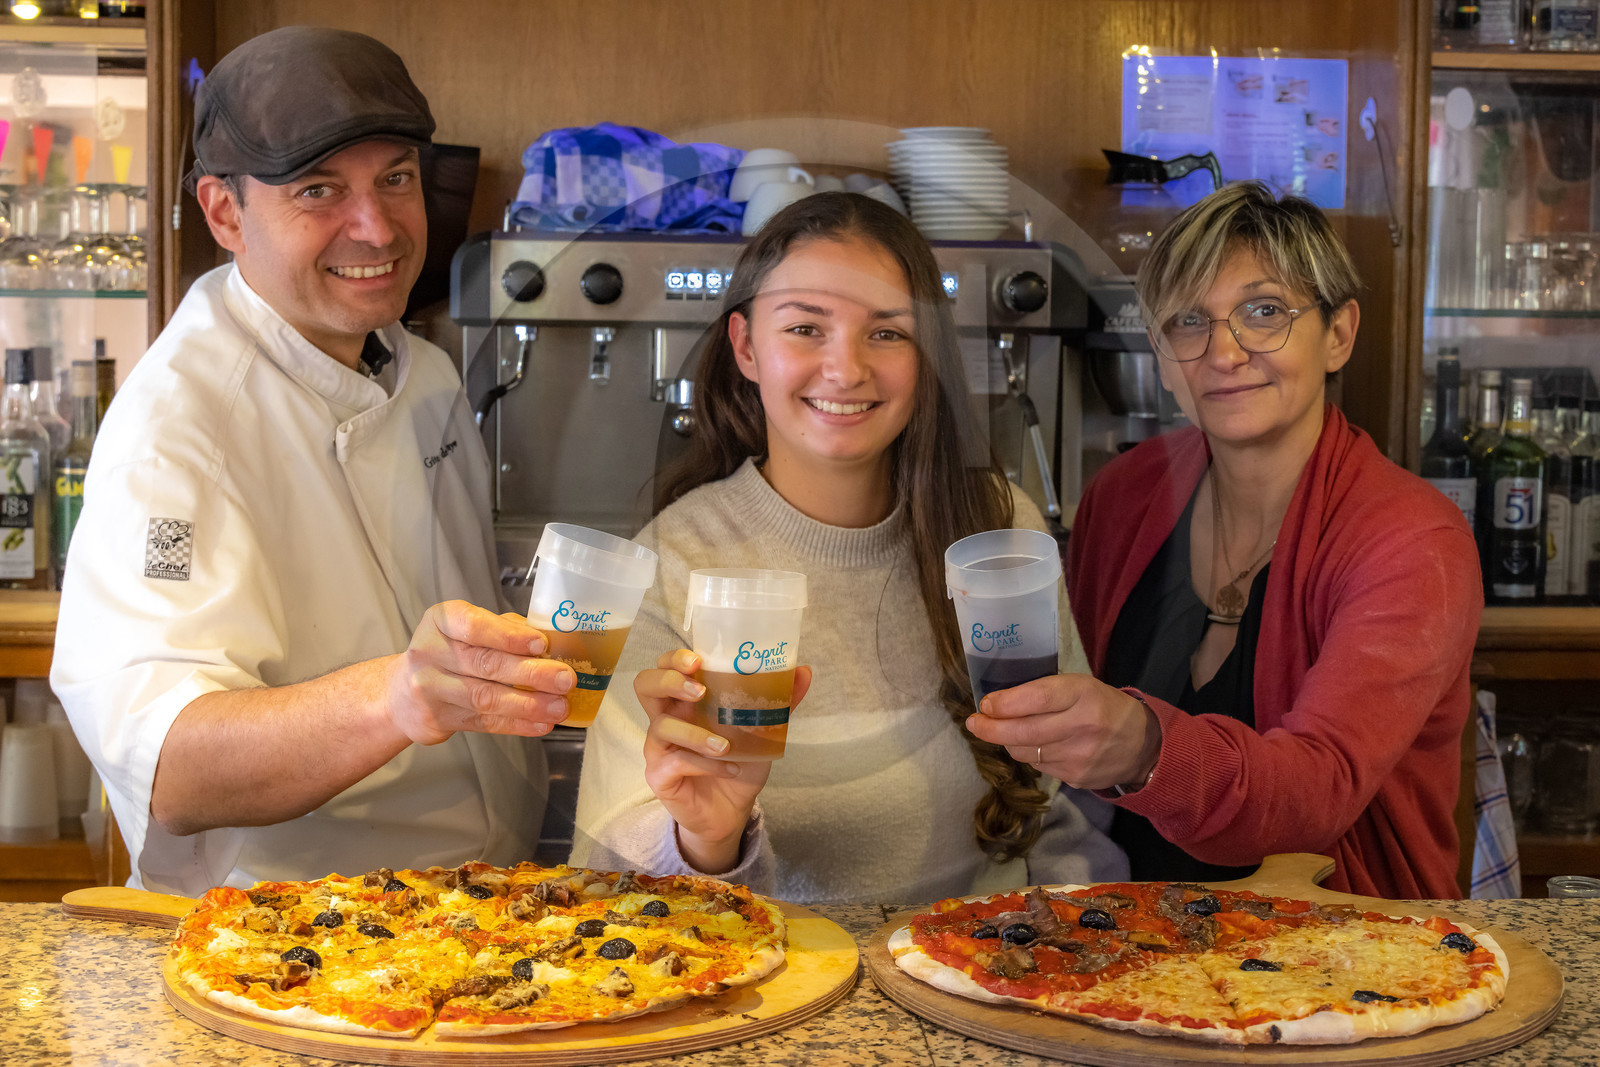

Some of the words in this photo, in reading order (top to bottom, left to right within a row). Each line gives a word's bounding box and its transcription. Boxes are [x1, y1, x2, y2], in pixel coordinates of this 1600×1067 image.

[1504, 494, 1534, 525] 51
[145, 569, 190, 580] PROFESSIONAL
[551, 600, 611, 633] Esprit
[581, 622, 609, 633] PARC
[971, 623, 1020, 652] Esprit
[996, 635, 1023, 646] PARC
[733, 641, 788, 675] Esprit
[765, 656, 788, 666] PARC
[764, 664, 787, 672] NATIONAL
